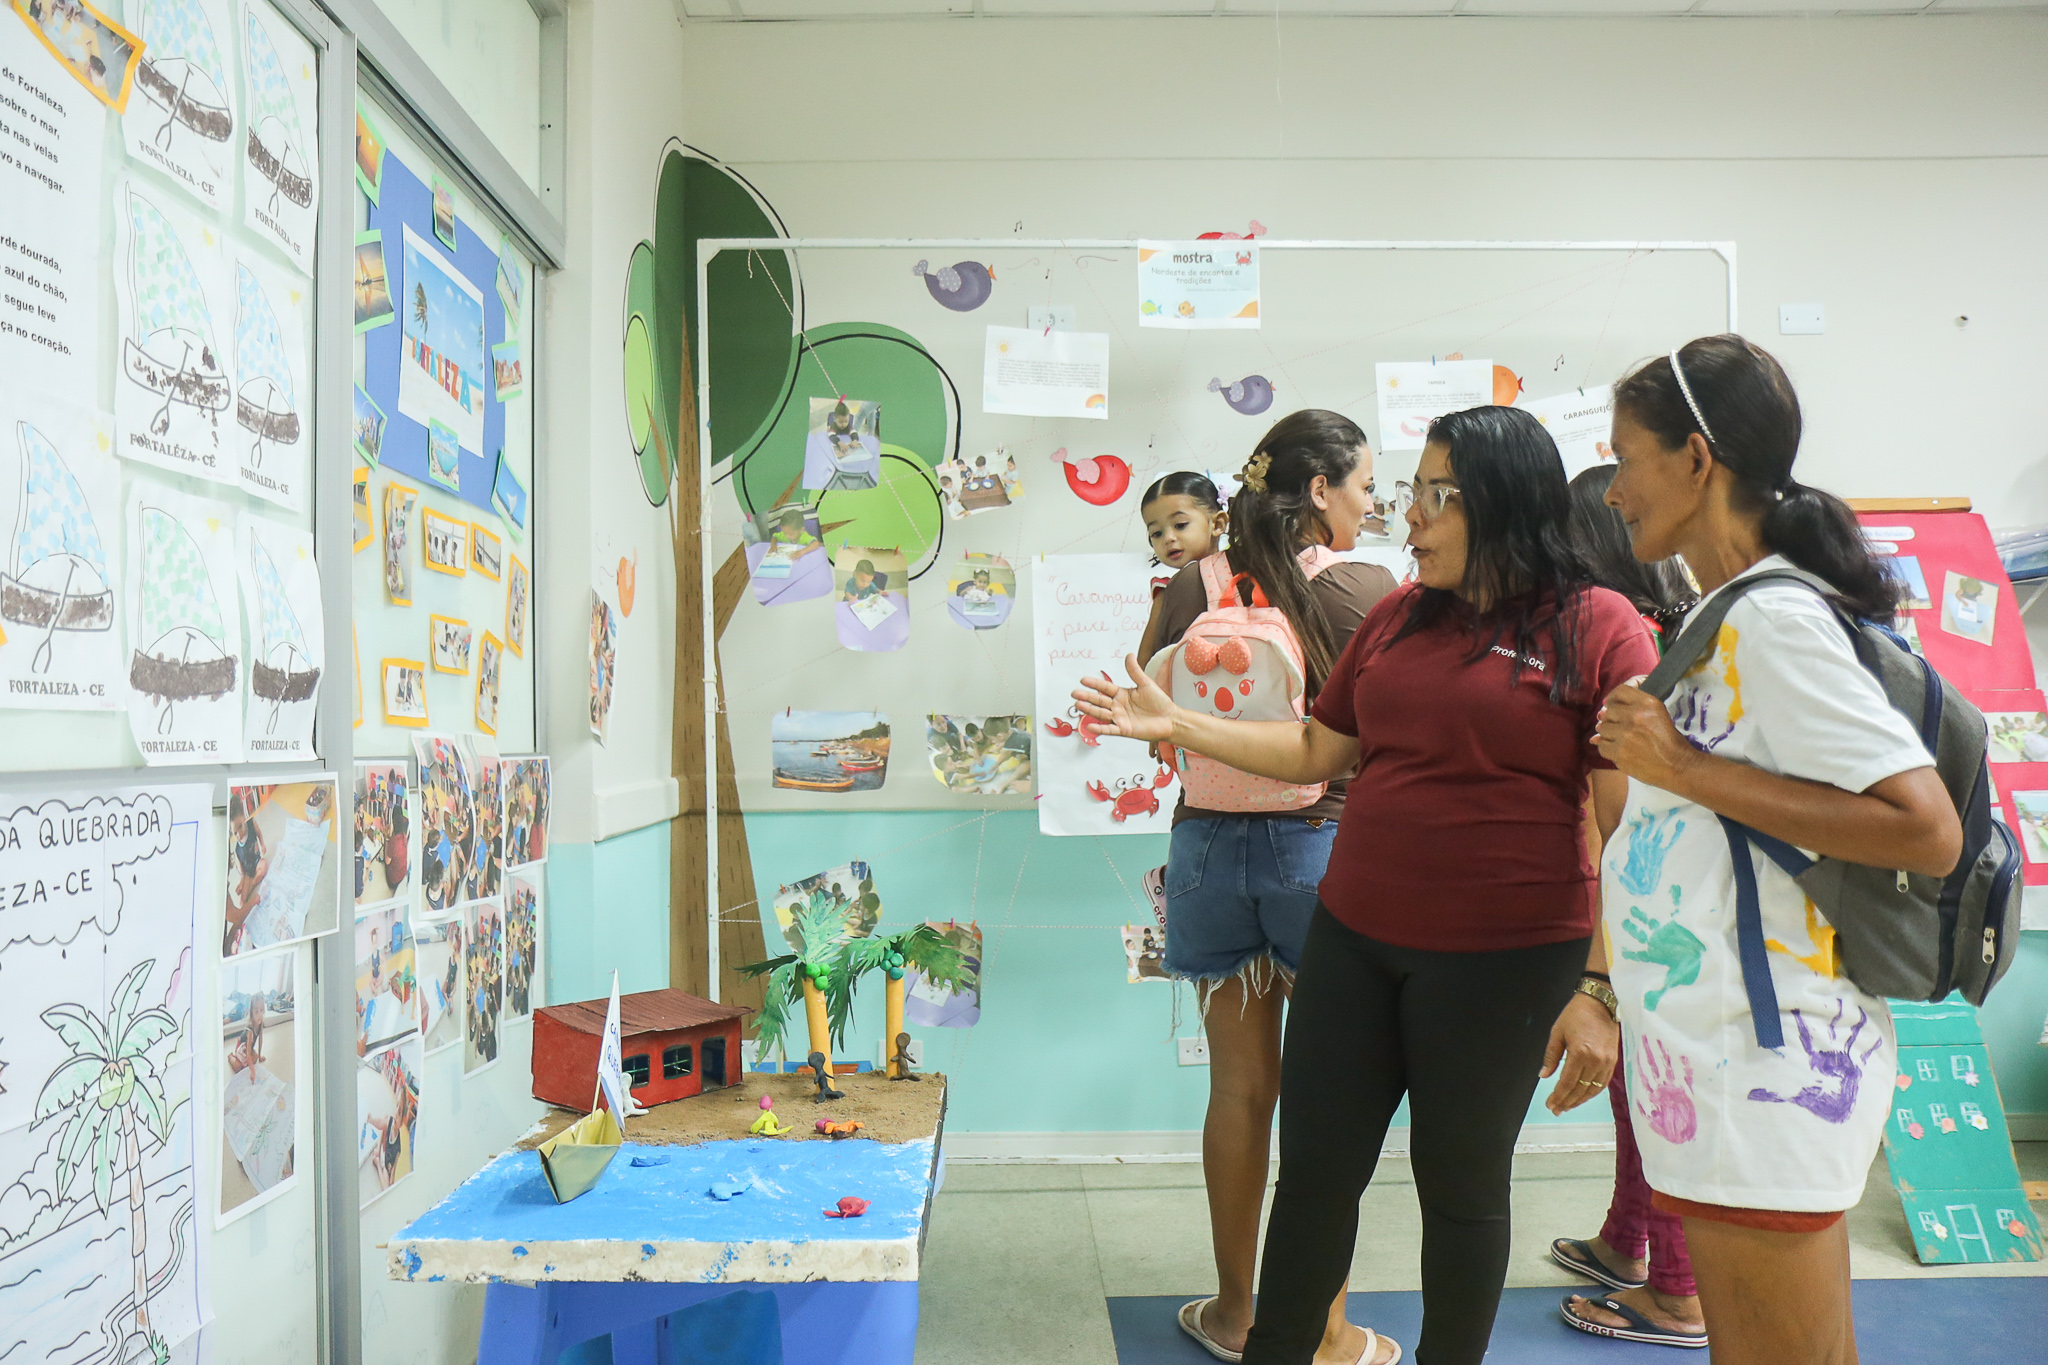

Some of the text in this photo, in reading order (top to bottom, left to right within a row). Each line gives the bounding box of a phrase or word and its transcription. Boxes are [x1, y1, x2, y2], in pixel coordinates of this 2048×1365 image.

[2, 66, 67, 118] de Fortaleza,
[0, 93, 60, 140] sobre o mar,
[13, 129, 31, 147] nas
[34, 142, 59, 164] velas
[0, 150, 65, 195] vo a navegar.
[139, 140, 195, 186] FORTALEZA
[201, 181, 216, 197] CE
[254, 207, 292, 247] FORTALEZA
[293, 242, 302, 256] CE
[0, 235, 62, 274] rde dourada,
[1172, 251, 1213, 264] mostra
[4, 264, 68, 304] azul do chão,
[1151, 267, 1186, 277] Nordeste
[1187, 268, 1197, 277] de
[1199, 269, 1233, 277] encantos
[1176, 277, 1212, 286] tradições
[4, 293, 56, 323] segue leve
[0, 320, 72, 356] ça no coração.
[1563, 404, 1612, 421] CARANGUEJO
[240, 467, 277, 491] FORTALEZA
[280, 483, 290, 495] CE
[1121, 616, 1147, 632] Car
[1490, 645, 1546, 671] Profeora
[9, 679, 80, 696] FORTALEZA
[89, 683, 105, 697] CE
[141, 740, 196, 753] FORTALEZA
[203, 740, 218, 752] CE
[251, 740, 288, 751] FORTALEZA
[291, 740, 301, 751] CE
[39, 809, 161, 849] QUEBRADA
[1578, 1320, 1615, 1337] crocs
